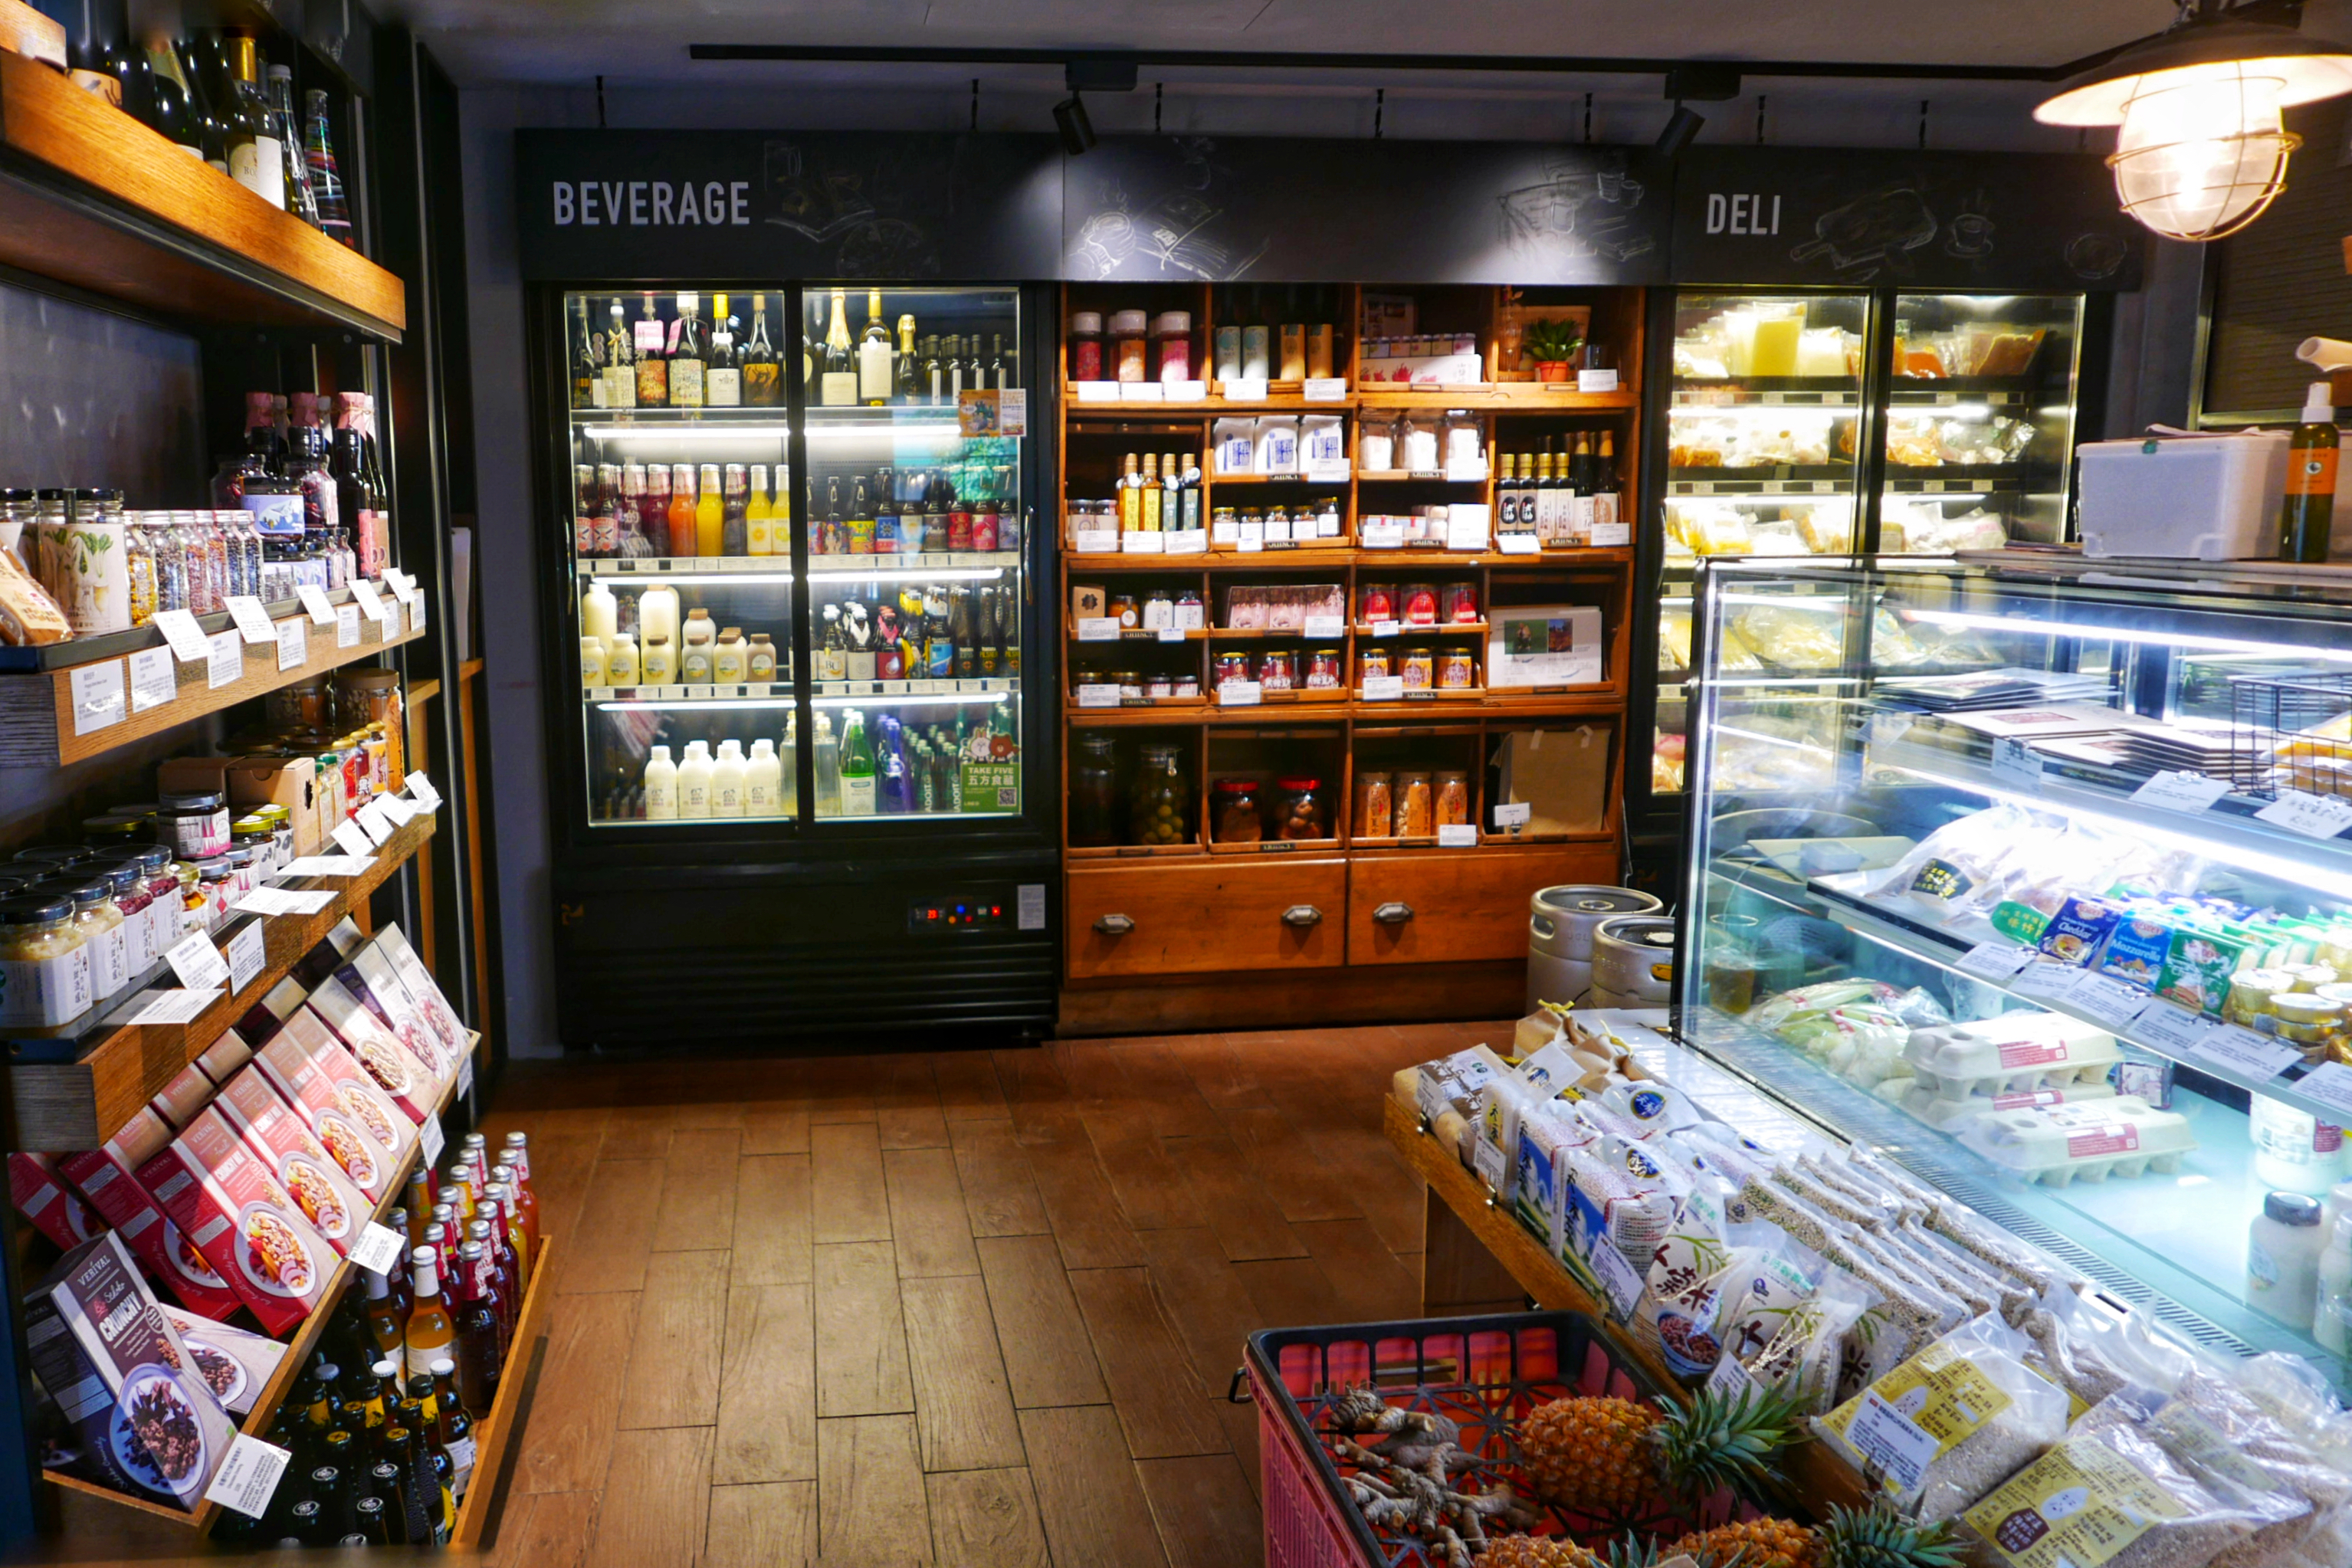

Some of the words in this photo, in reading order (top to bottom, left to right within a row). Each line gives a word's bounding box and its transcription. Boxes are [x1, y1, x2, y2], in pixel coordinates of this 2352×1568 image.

[553, 181, 750, 225] BEVERAGE
[1706, 193, 1781, 235] DELI
[923, 782, 932, 812] ADOIT
[952, 782, 961, 812] ADOIT
[2058, 921, 2093, 939] Cheddar
[2111, 937, 2161, 963] Mozzarella
[99, 1291, 143, 1342] CRUNCHY
